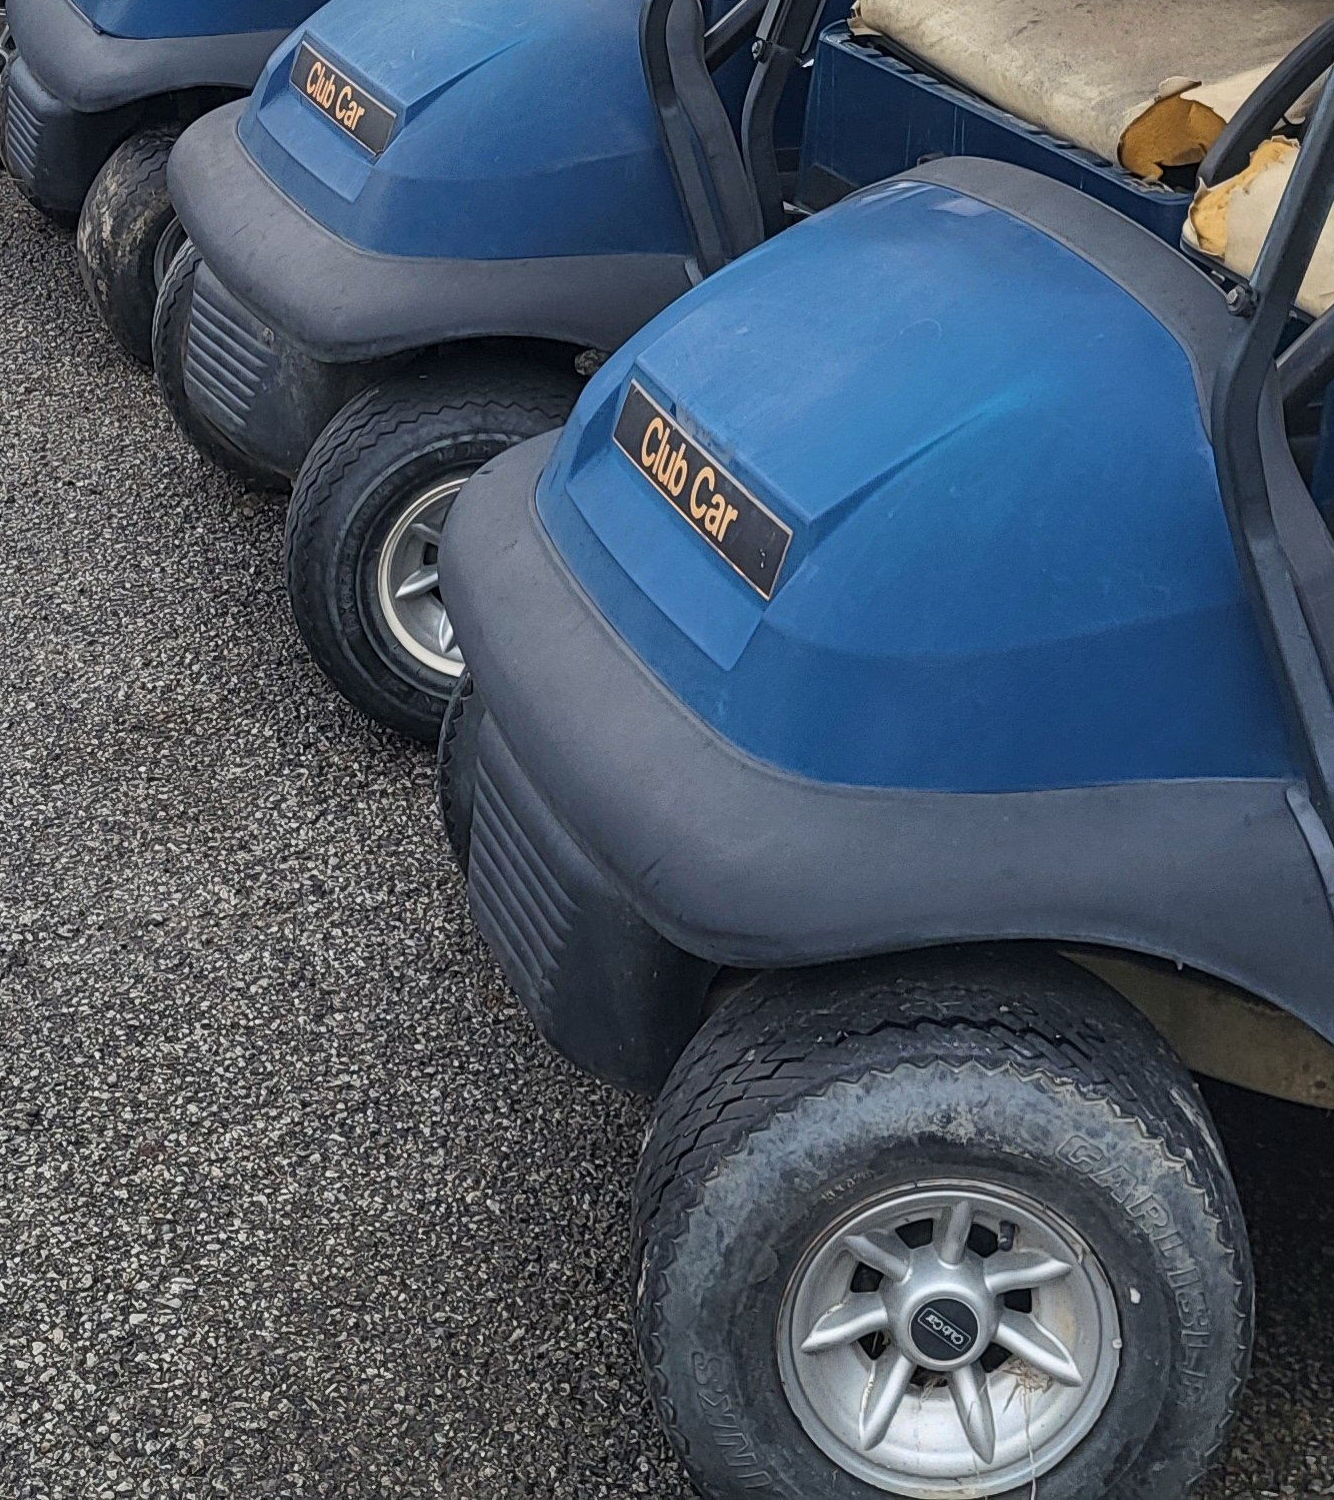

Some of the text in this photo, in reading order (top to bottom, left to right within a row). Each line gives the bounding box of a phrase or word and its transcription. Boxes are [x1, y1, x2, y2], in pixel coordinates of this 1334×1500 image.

[306, 61, 366, 131] Club Car
[640, 416, 740, 543] Club Car
[925, 1314, 964, 1346] Club Car
